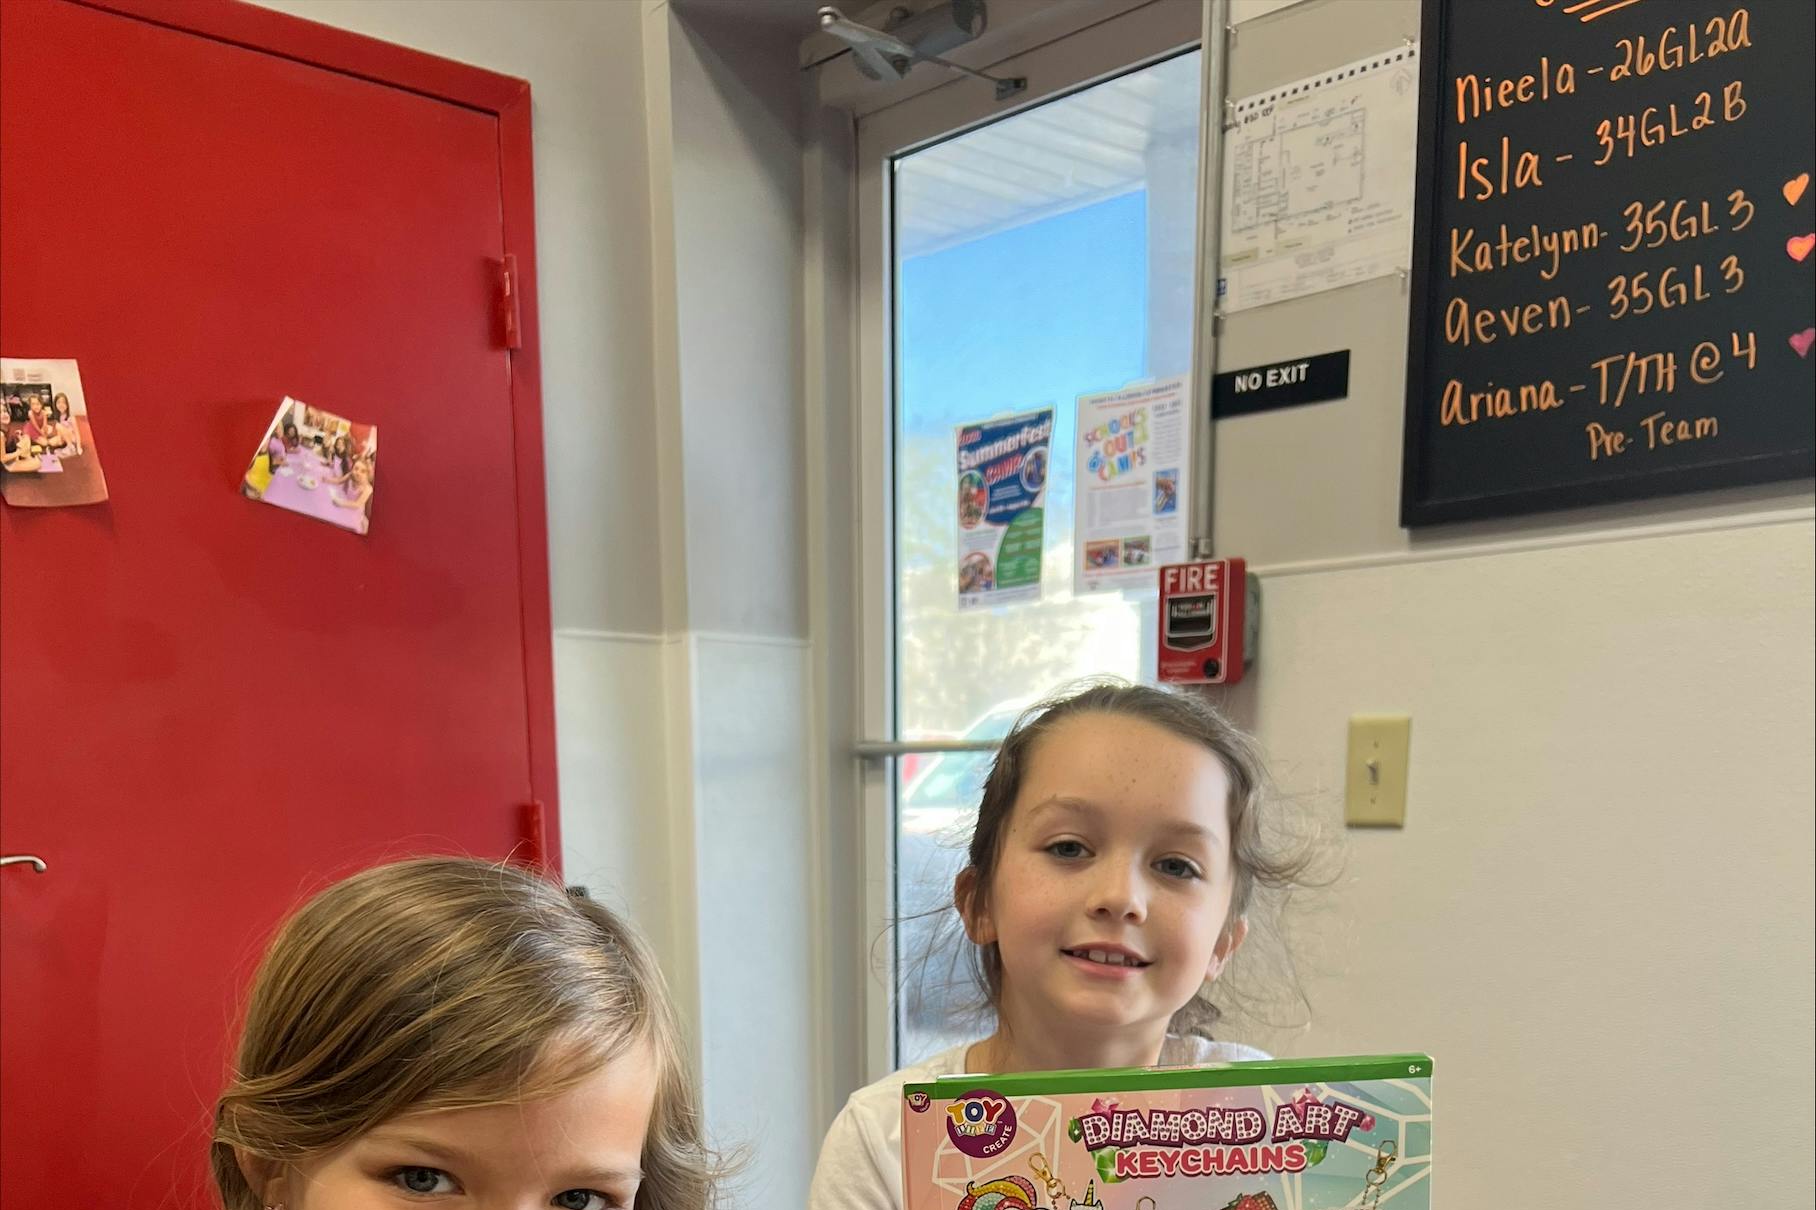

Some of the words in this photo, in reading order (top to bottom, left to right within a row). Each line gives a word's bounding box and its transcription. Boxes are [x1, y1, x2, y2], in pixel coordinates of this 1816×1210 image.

[1458, 137, 1542, 199] Isla
[1732, 332, 1757, 370] 4
[1234, 374, 1262, 393] NO
[1266, 363, 1310, 388] EXIT
[1164, 564, 1220, 592] FIRE
[1408, 1065, 1422, 1074] 6+
[946, 1099, 1004, 1125] TOY
[1082, 1109, 1260, 1146] DIAMOND
[1275, 1103, 1359, 1137] ART
[983, 1125, 1012, 1154] CREATE
[1115, 1144, 1306, 1176] KEYCHAINS
